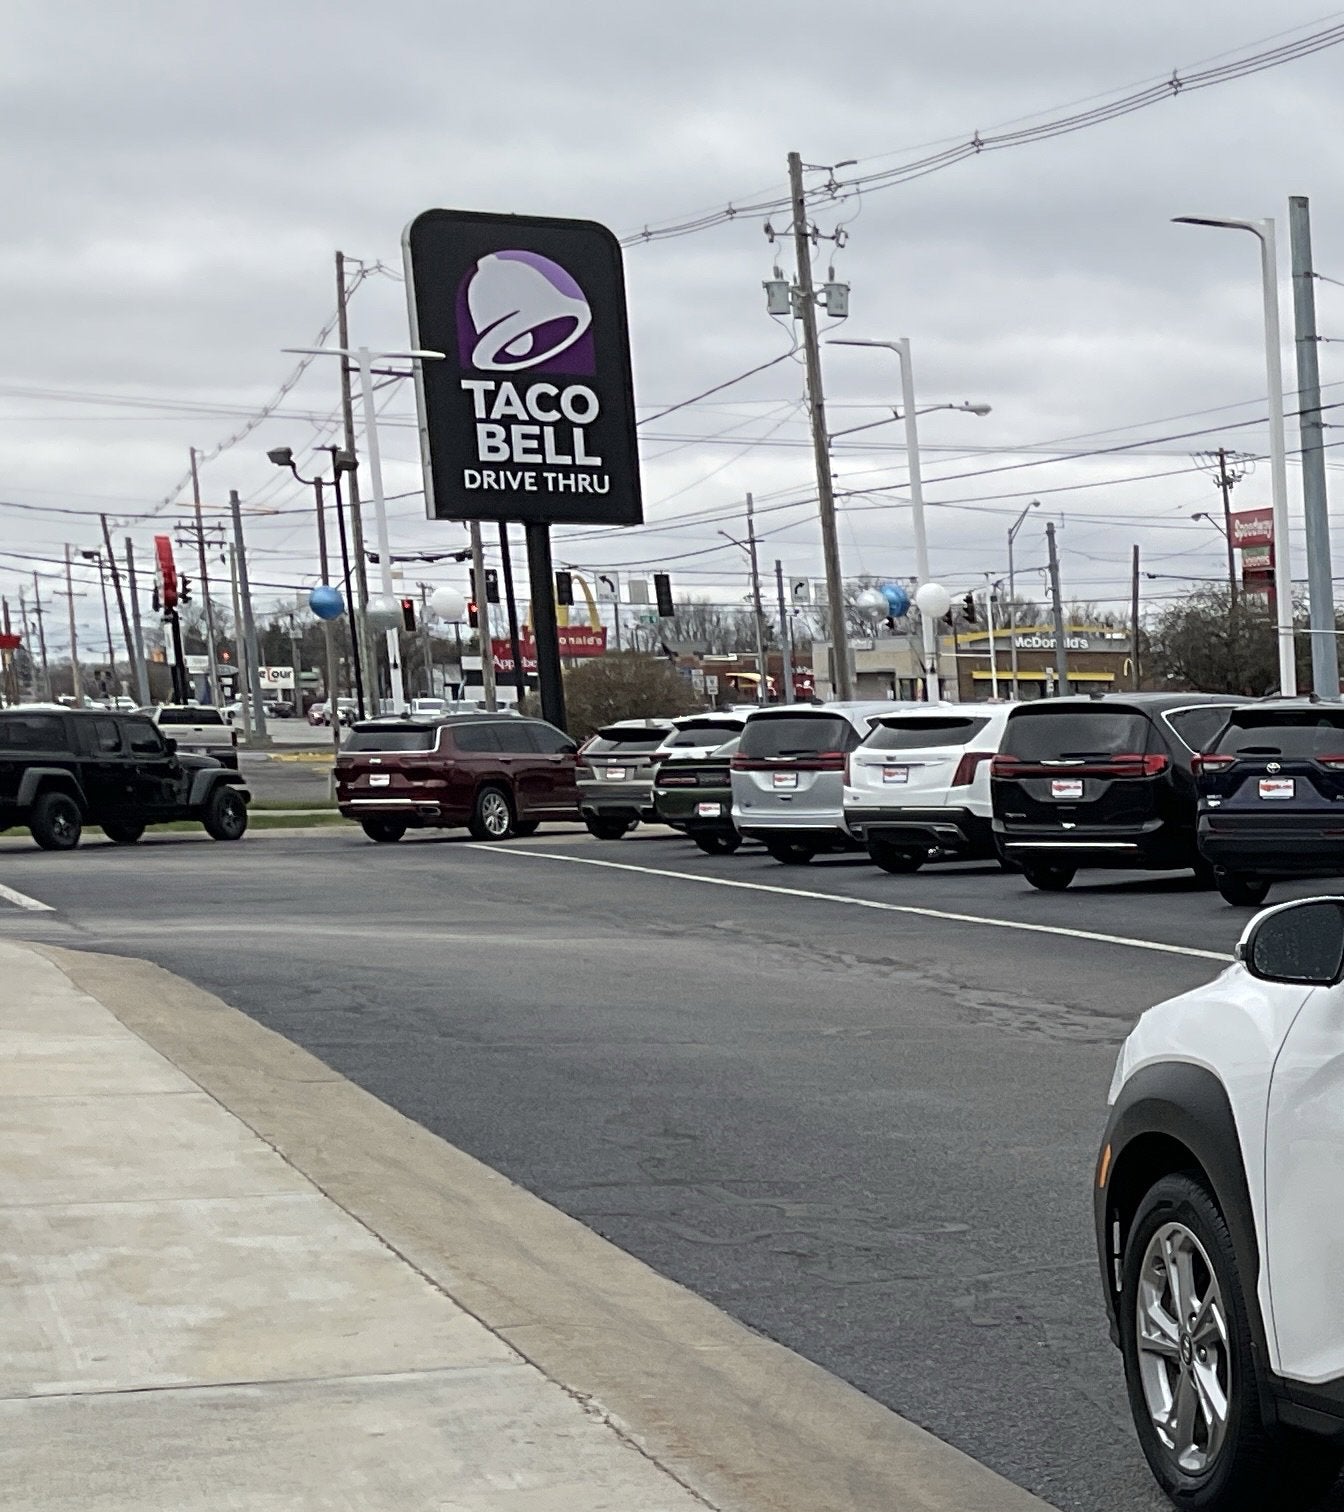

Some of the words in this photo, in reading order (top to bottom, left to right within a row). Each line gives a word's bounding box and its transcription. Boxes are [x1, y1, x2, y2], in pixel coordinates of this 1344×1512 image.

[461, 379, 600, 424] TACO
[476, 423, 602, 467] BELL
[463, 469, 538, 491] DRIVE
[543, 472, 610, 494] THRU
[1234, 517, 1274, 541] Speedway
